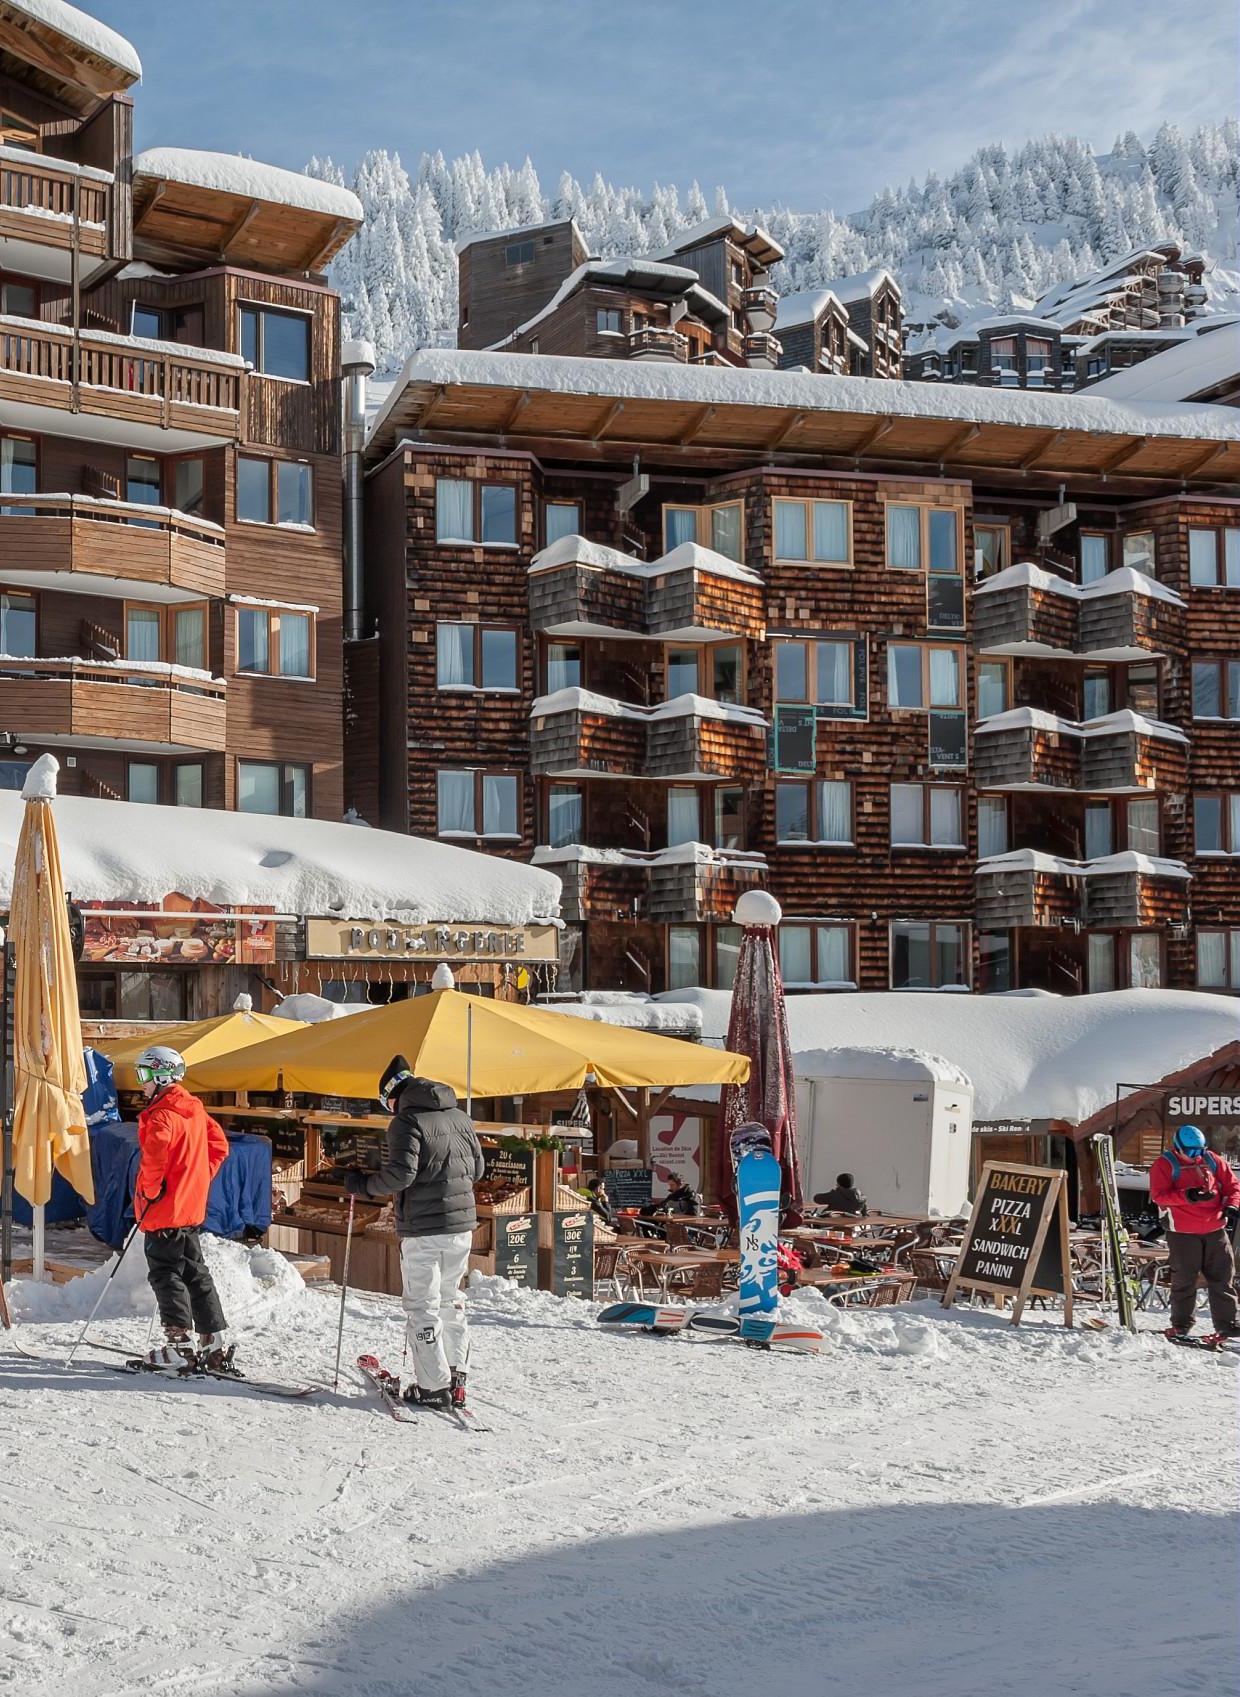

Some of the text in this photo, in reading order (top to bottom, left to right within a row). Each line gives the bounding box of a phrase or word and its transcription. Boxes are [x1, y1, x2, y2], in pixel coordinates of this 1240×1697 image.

[990, 1173, 1047, 1196] BAKERY
[990, 1197, 1032, 1219] PIZZA
[509, 1233, 527, 1244] 20€
[566, 1230, 582, 1241] 30€
[971, 1238, 1030, 1261] SANDWICH
[513, 1253, 520, 1264] 6
[570, 1266, 577, 1276] 3
[975, 1260, 1014, 1280] PANINI
